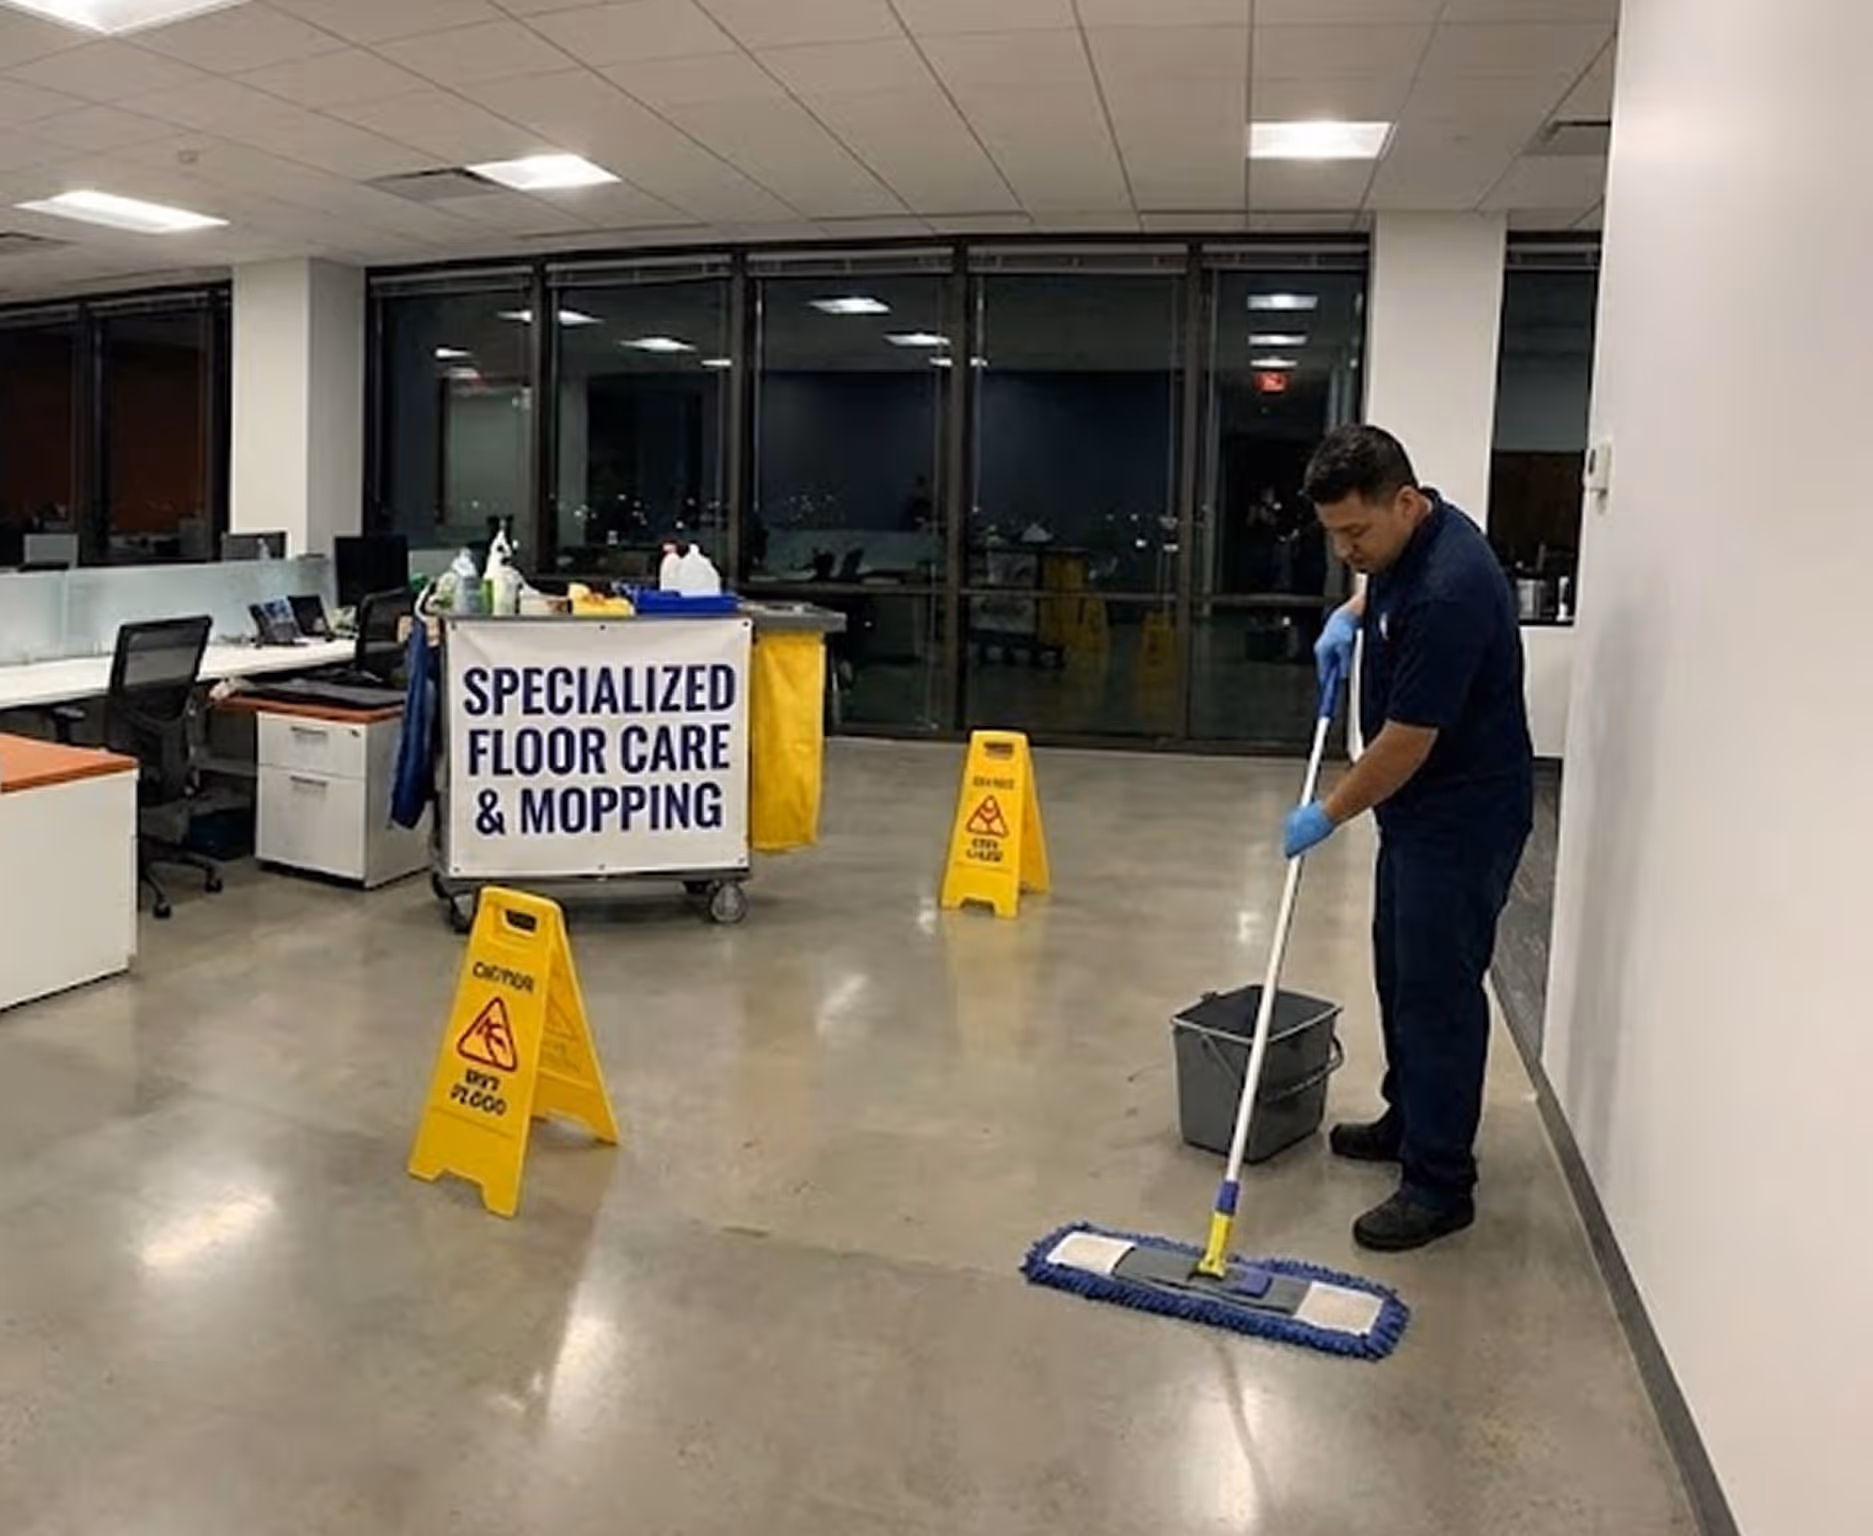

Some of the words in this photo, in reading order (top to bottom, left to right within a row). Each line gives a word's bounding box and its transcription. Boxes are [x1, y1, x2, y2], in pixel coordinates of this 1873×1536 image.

[463, 664, 736, 715] SPECIALIZED
[468, 727, 606, 776] FLOOR
[621, 724, 731, 774] CARE
[476, 788, 506, 835] &
[521, 782, 722, 834] MOPPING
